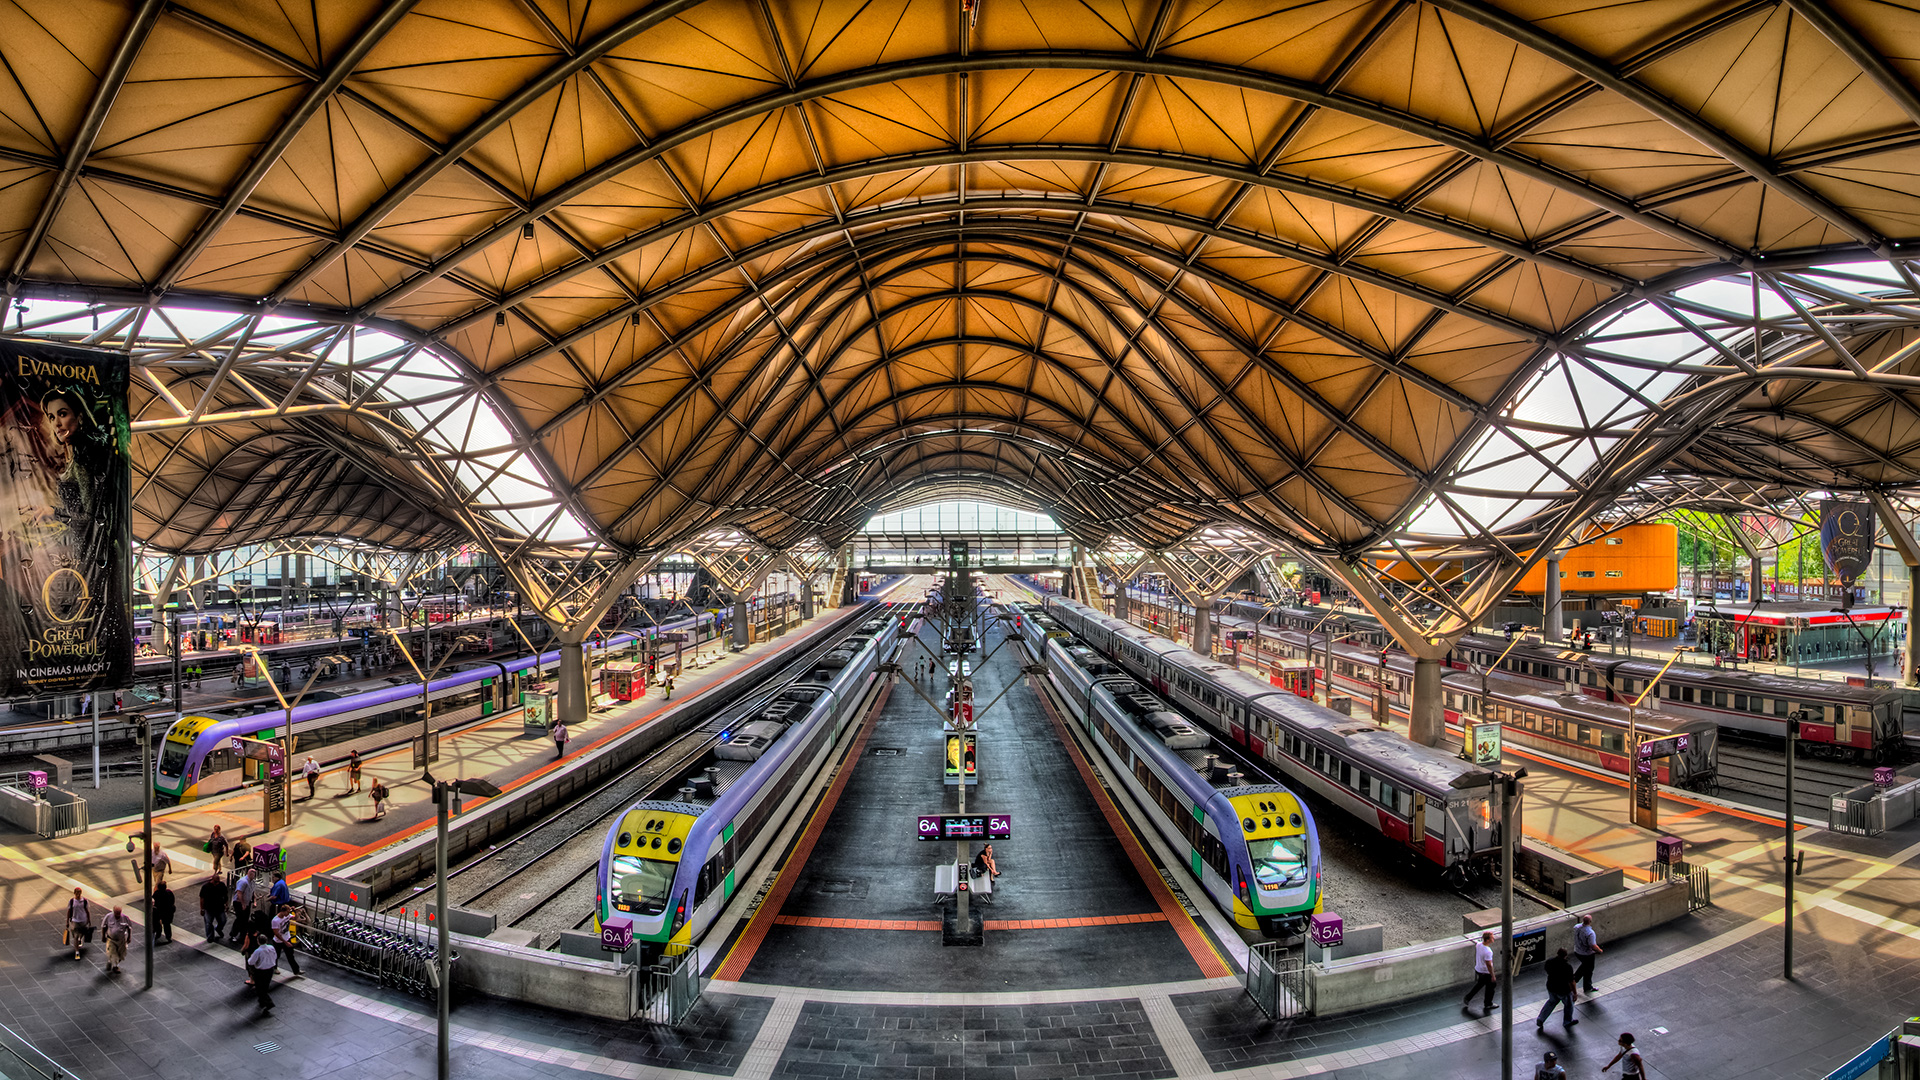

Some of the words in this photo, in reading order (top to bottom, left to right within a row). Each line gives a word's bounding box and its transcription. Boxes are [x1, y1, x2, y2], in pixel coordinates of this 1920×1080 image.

[18, 355, 100, 386] EVANORA
[43, 626, 87, 643] GREAT
[29, 637, 106, 662] POWERFUL
[16, 669, 28, 678] IN
[29, 665, 72, 677] CINEMAS
[73, 662, 104, 674] MARCH
[106, 662, 111, 670] 7
[232, 740, 244, 750] 8A
[1678, 738, 1688, 747] 3A
[268, 746, 279, 756] 7A
[1642, 745, 1652, 754] 4A
[36, 776, 46, 786] 8A
[1874, 772, 1885, 782] 3A
[920, 820, 938, 832] 6A
[990, 818, 1008, 830] 5A
[1658, 846, 1669, 858] 4A
[1670, 846, 1682, 856] 4A
[254, 852, 265, 864] 7A
[268, 852, 278, 864] 7A
[624, 928, 632, 942] 6A
[1312, 921, 1320, 938] 5A
[1322, 926, 1341, 939] 5A
[603, 929, 622, 944] 6A
[1514, 935, 1544, 948] Luggage
